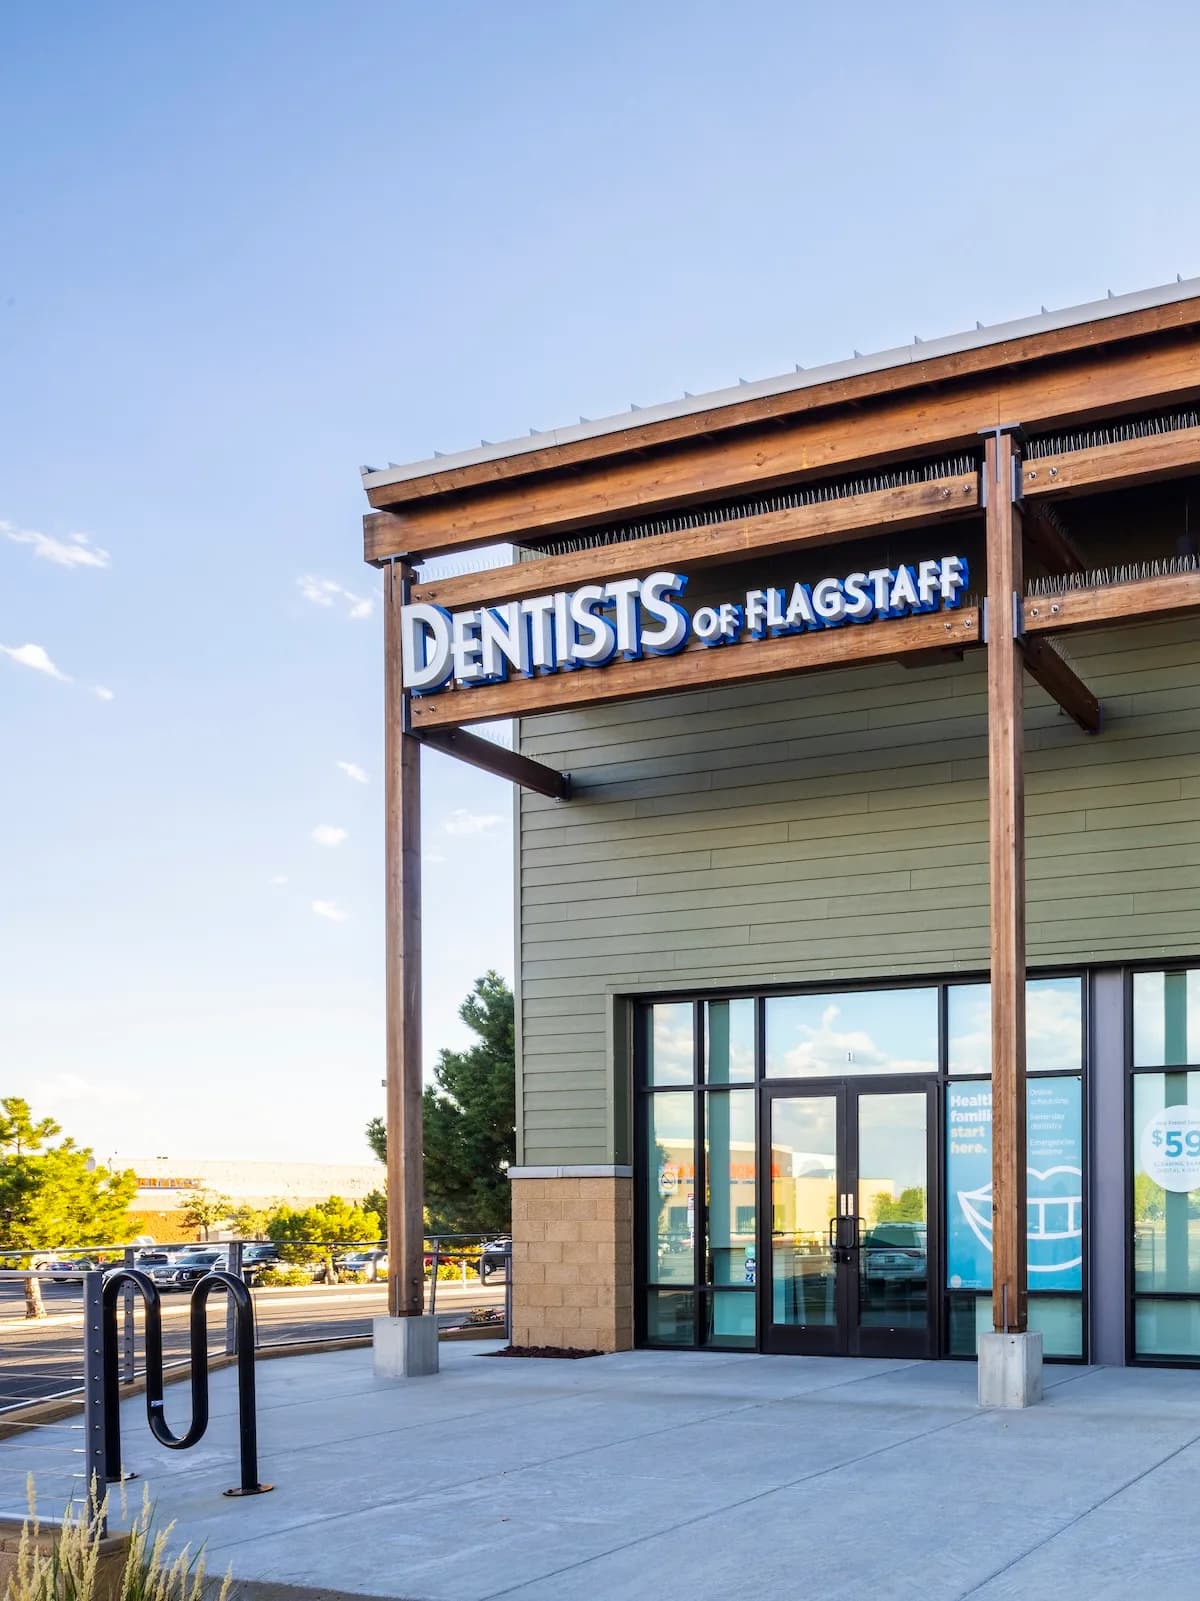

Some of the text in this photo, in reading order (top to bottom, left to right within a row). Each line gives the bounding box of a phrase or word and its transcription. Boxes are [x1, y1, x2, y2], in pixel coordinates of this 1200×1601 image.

[400, 556, 968, 694] DENTISTS OF FLAGSTAFF
[951, 1094, 992, 1106] Healt
[951, 1110, 992, 1122] famili
[951, 1126, 985, 1137] start
[951, 1142, 987, 1153] here.
